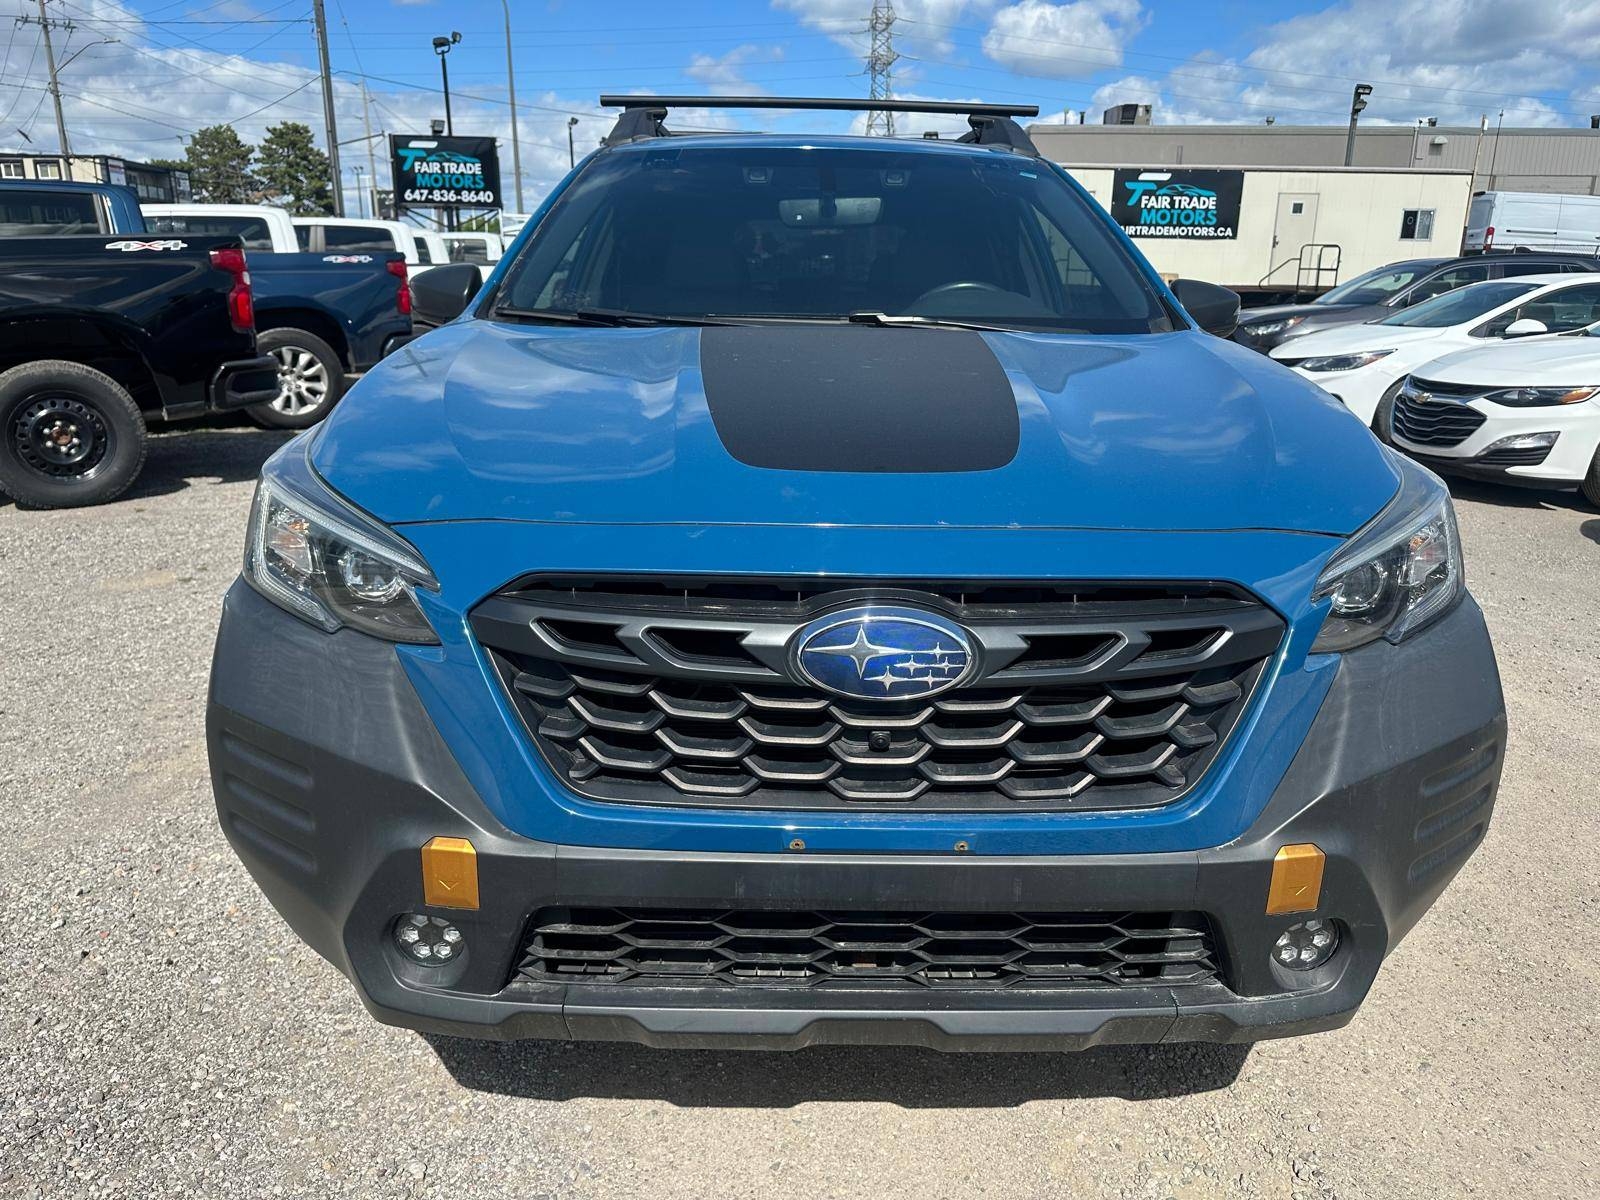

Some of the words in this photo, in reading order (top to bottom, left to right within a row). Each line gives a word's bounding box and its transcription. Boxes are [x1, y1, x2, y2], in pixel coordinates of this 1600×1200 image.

[413, 161, 441, 174] FAIR
[442, 162, 482, 175] TRADE
[416, 173, 485, 189] MOTORS
[404, 189, 494, 203] 647-836-8640
[1140, 195, 1171, 209] FAIR
[1173, 196, 1217, 210] TRADE
[1140, 208, 1217, 225] MOTORS
[1121, 225, 1233, 237] IRTRADEMOTORS.CA
